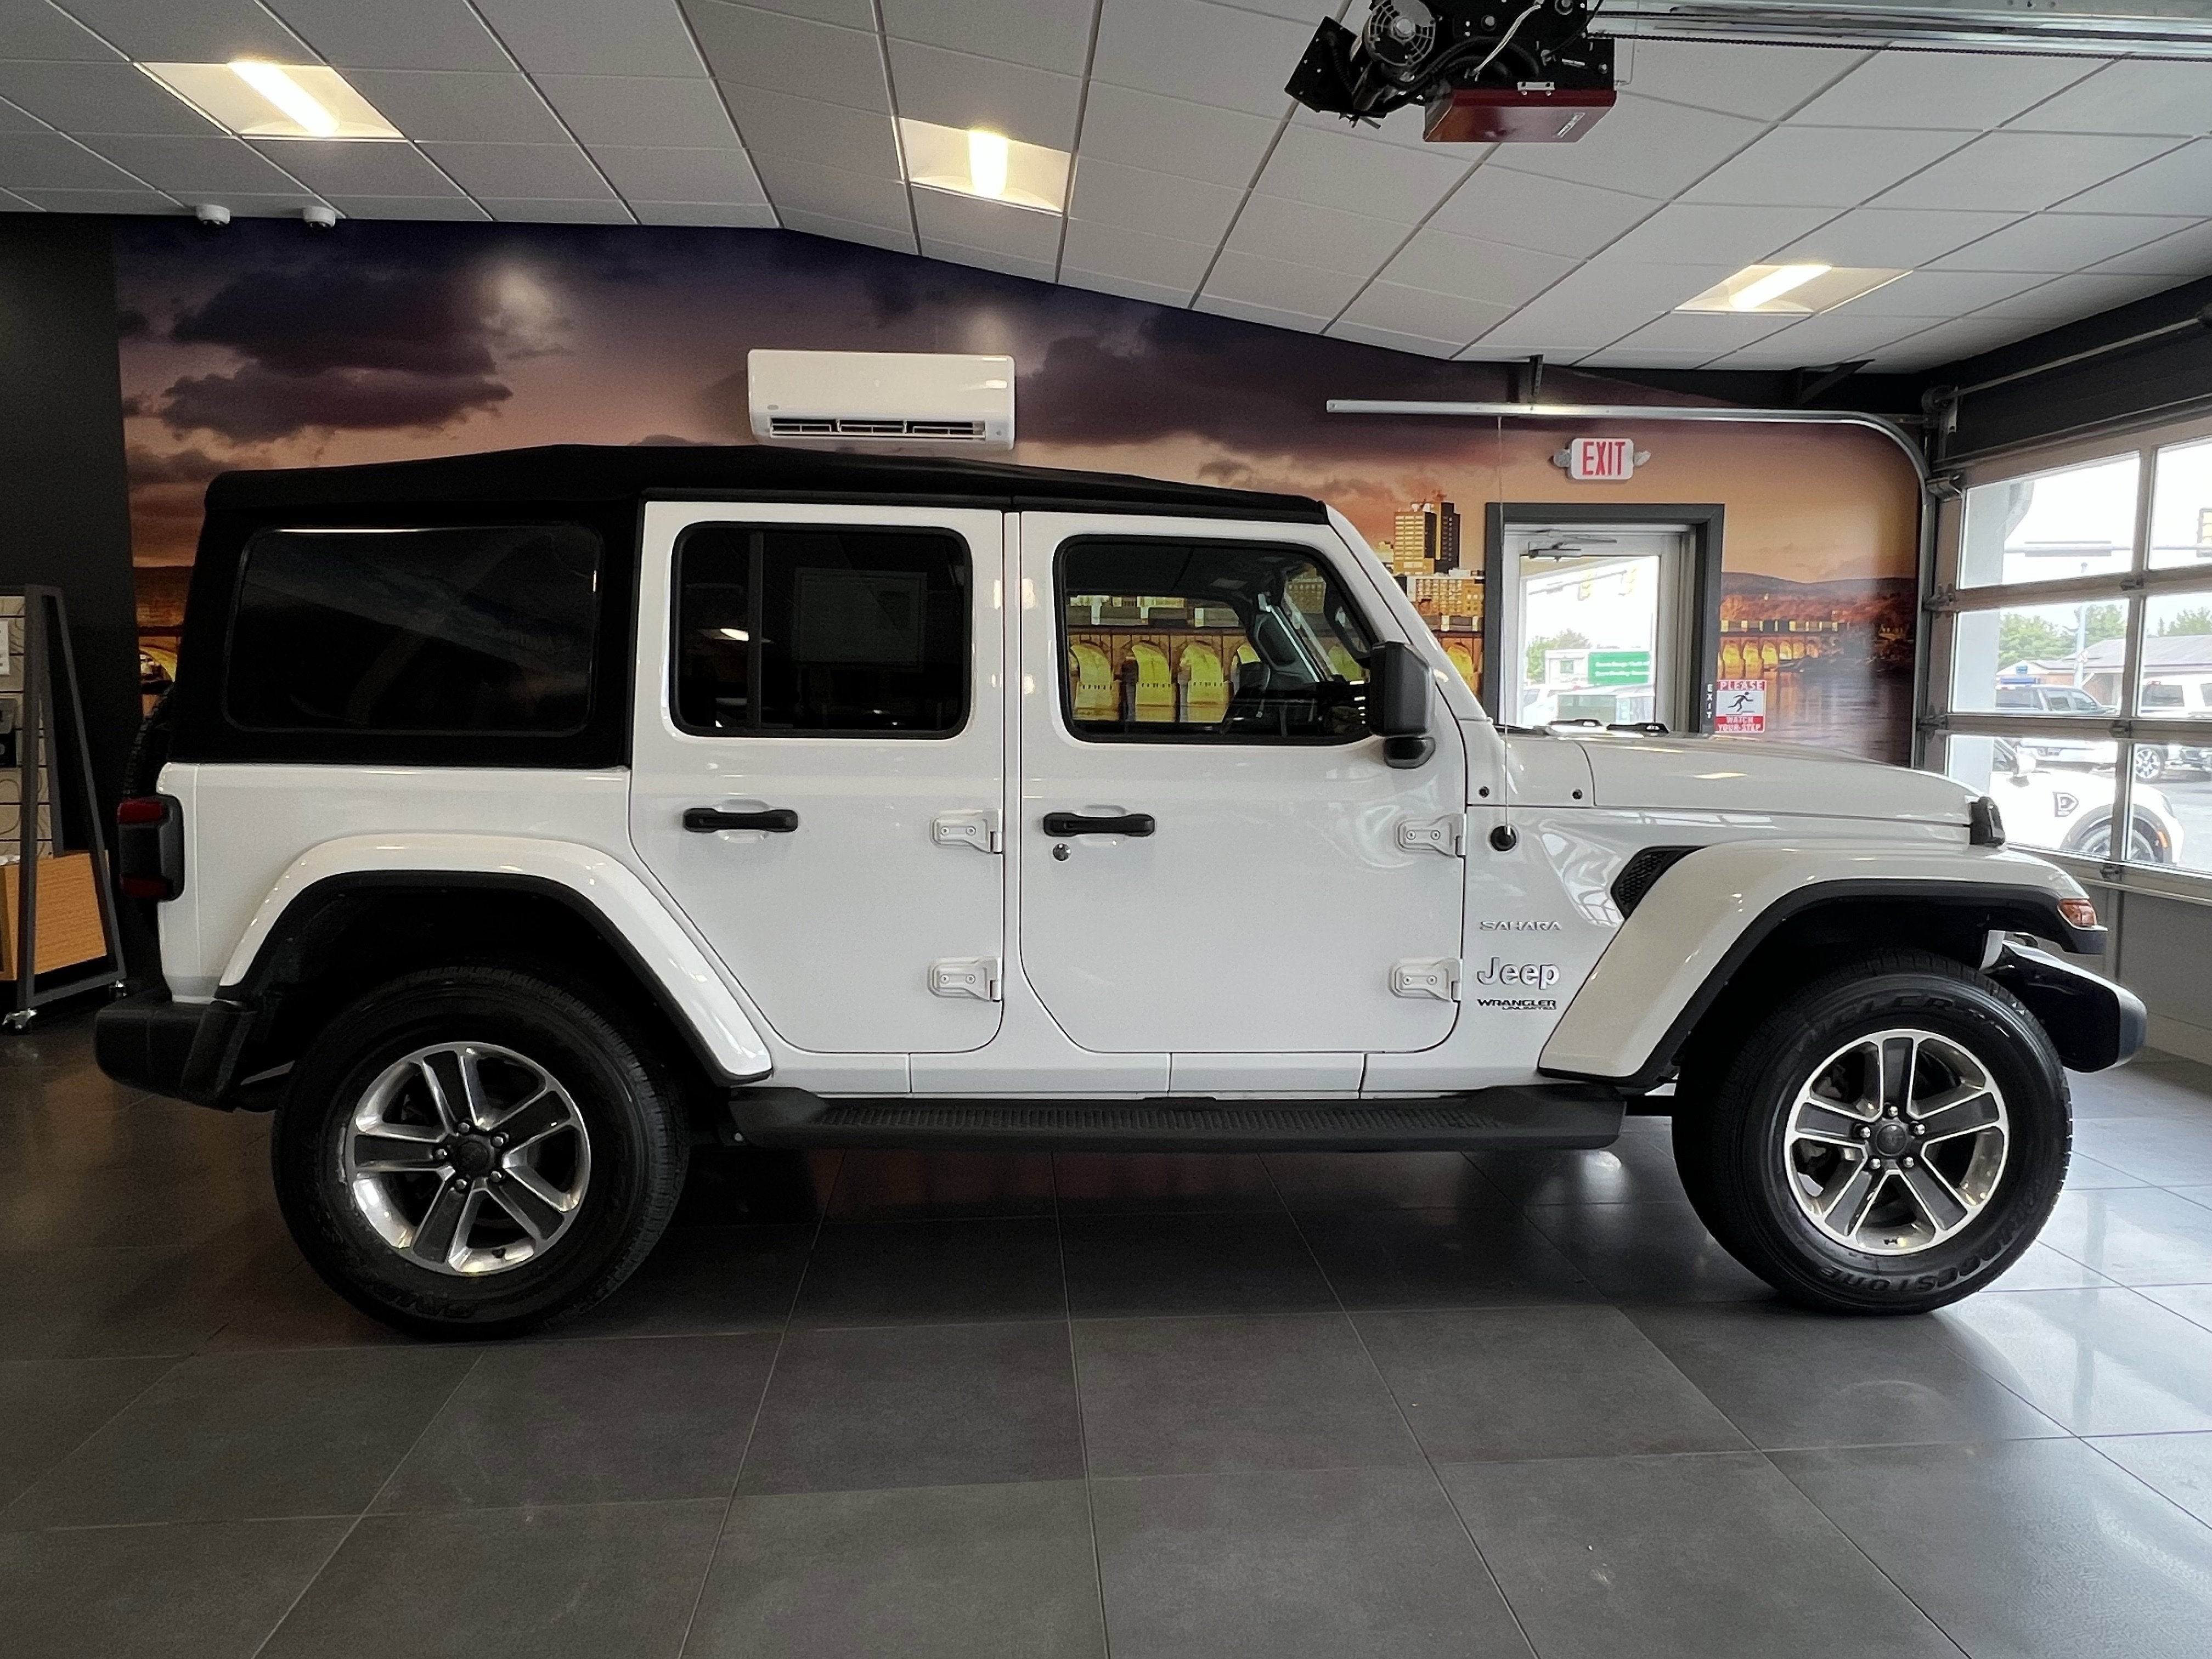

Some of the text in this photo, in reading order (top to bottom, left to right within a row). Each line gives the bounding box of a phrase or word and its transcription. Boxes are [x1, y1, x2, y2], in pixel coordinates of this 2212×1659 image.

[1582, 441, 1626, 476] EXIT
[1720, 680, 1763, 691] PLEASE
[1718, 723, 1761, 731] YOUR STEP
[1480, 921, 1562, 931] SAHARA
[1477, 957, 1560, 990] Jeep
